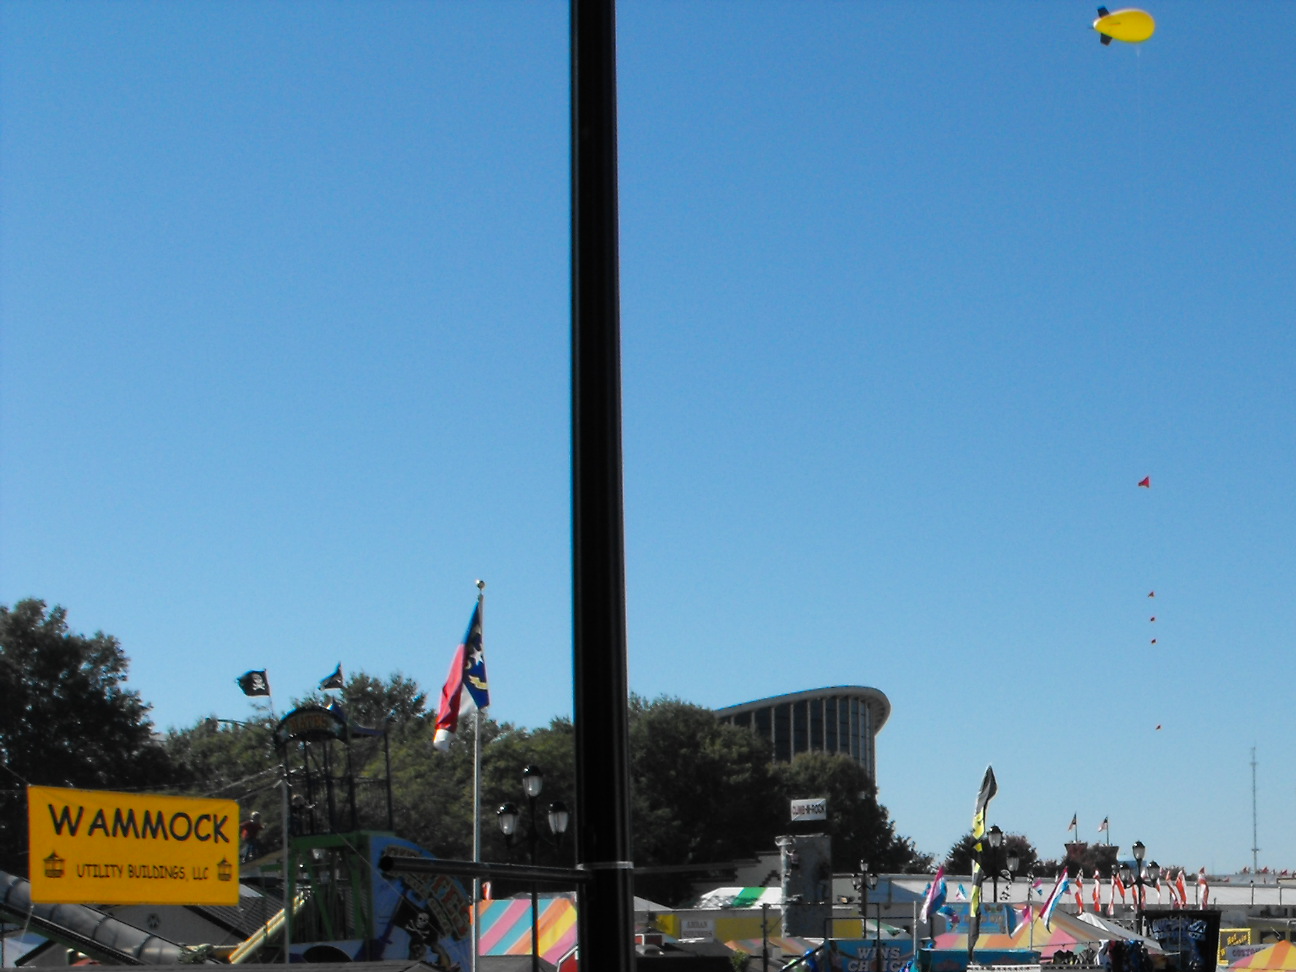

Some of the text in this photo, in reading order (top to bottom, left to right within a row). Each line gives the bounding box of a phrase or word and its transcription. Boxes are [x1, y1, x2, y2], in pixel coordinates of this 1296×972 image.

[48, 803, 230, 844] WAMMOCK
[77, 863, 209, 882] UTILITY BUILDINGS, LLC
[857, 947, 900, 961] WINS
